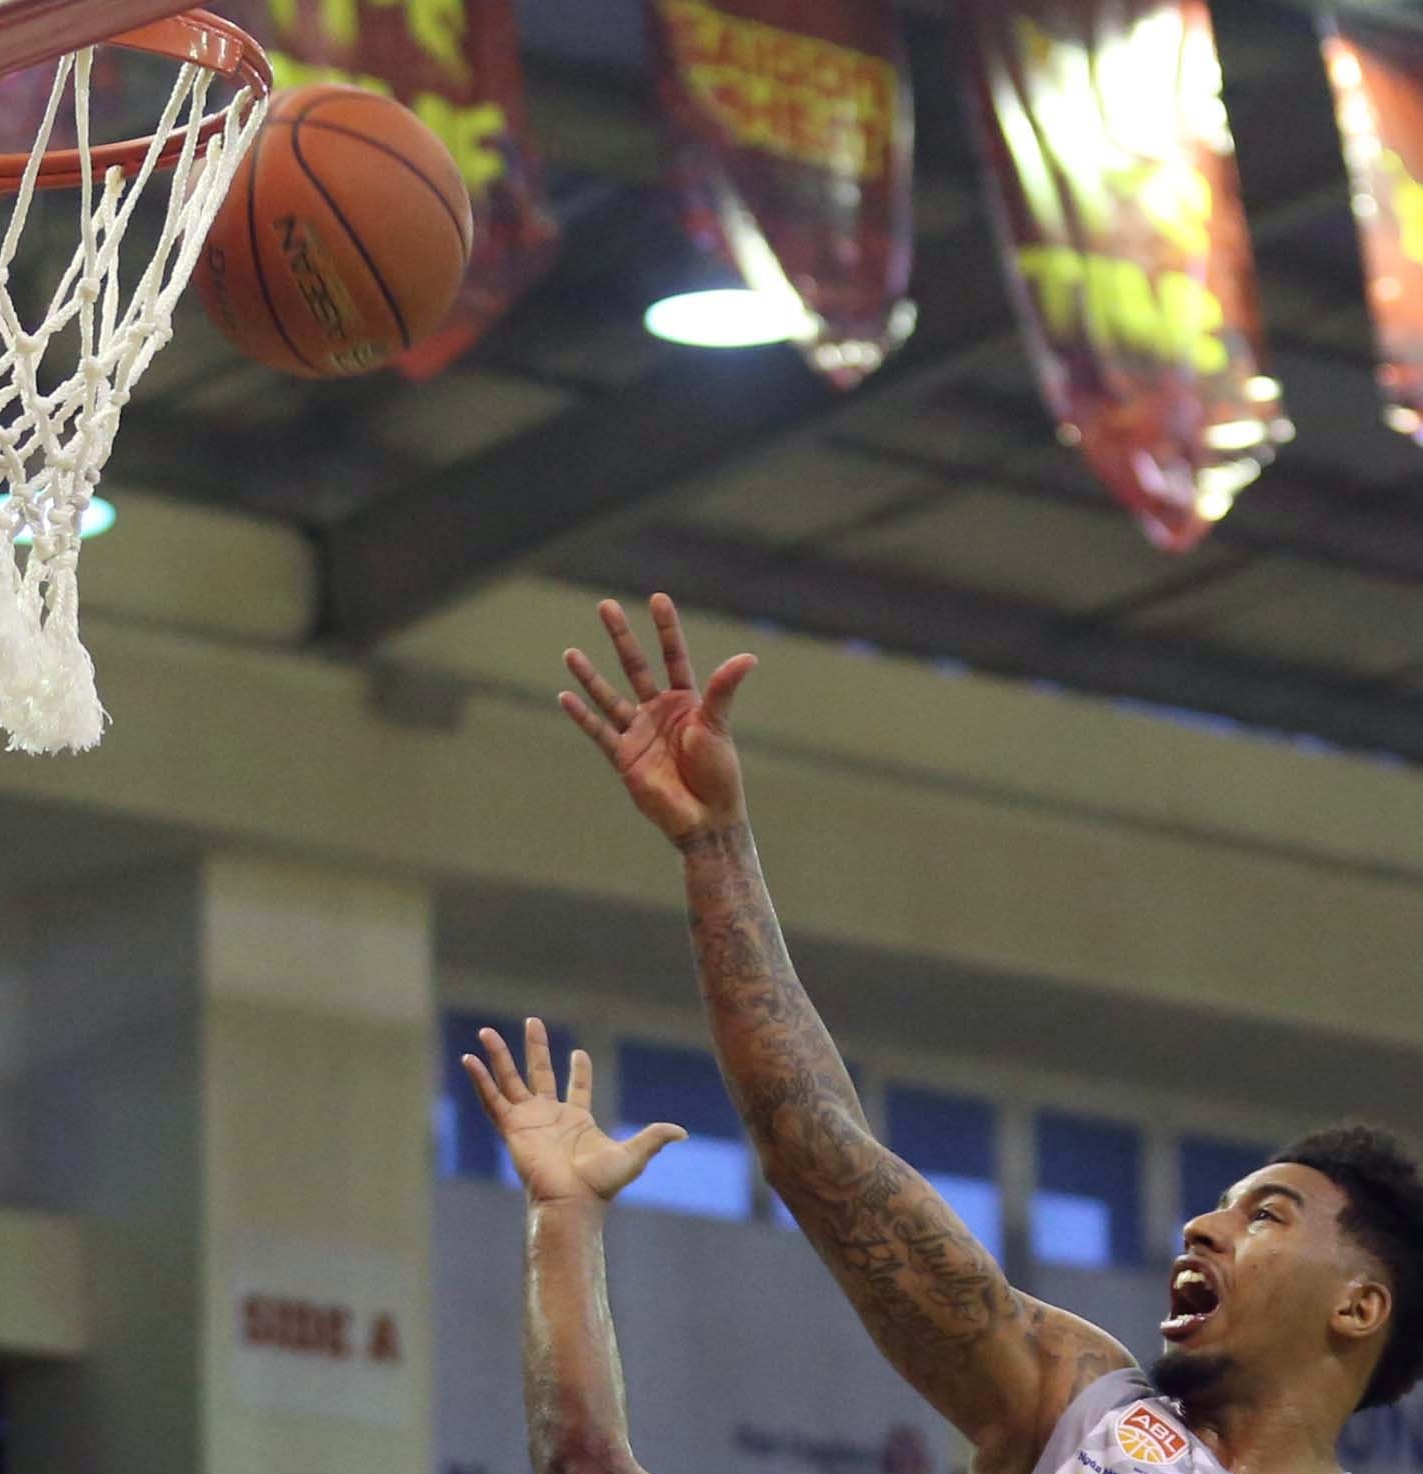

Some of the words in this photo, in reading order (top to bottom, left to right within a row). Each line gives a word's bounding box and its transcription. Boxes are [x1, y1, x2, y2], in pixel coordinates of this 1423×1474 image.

[243, 1293, 351, 1362] SIDE
[367, 1312, 402, 1366] A
[1129, 1413, 1177, 1454] ABL
